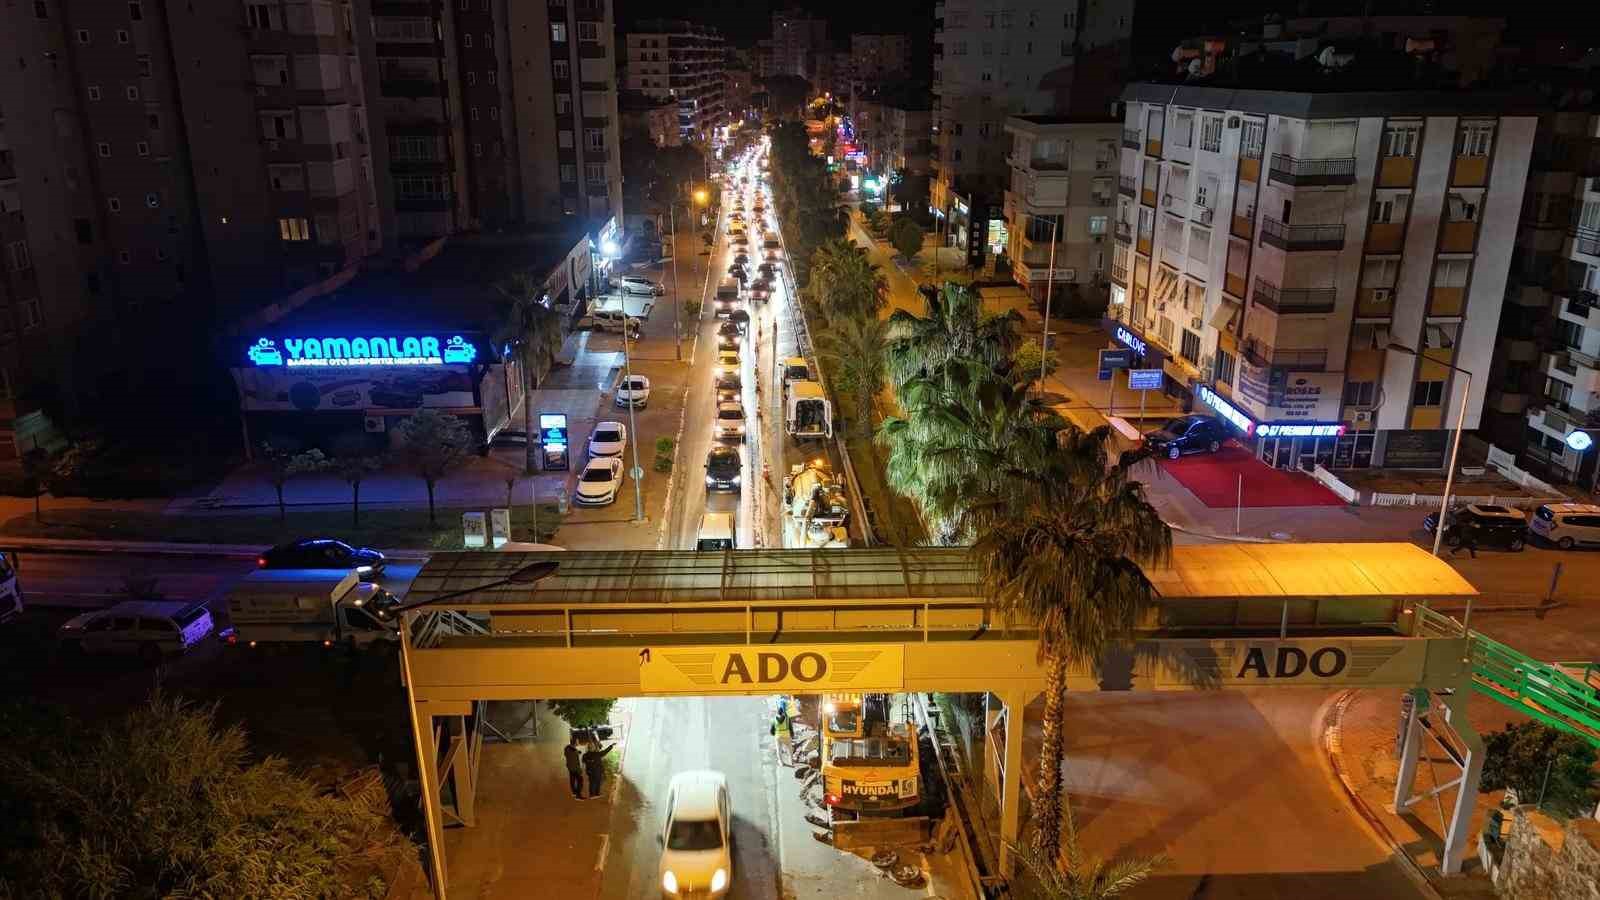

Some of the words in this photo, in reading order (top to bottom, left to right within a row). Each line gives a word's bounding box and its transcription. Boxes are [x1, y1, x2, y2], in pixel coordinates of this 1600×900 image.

[284, 337, 440, 358] YAMANLAR
[1117, 327, 1147, 356] CARLOVE
[329, 358, 347, 366] OTO
[720, 652, 828, 685] ADO
[1235, 647, 1347, 679] ADO
[843, 784, 899, 796] HYUNDAI
